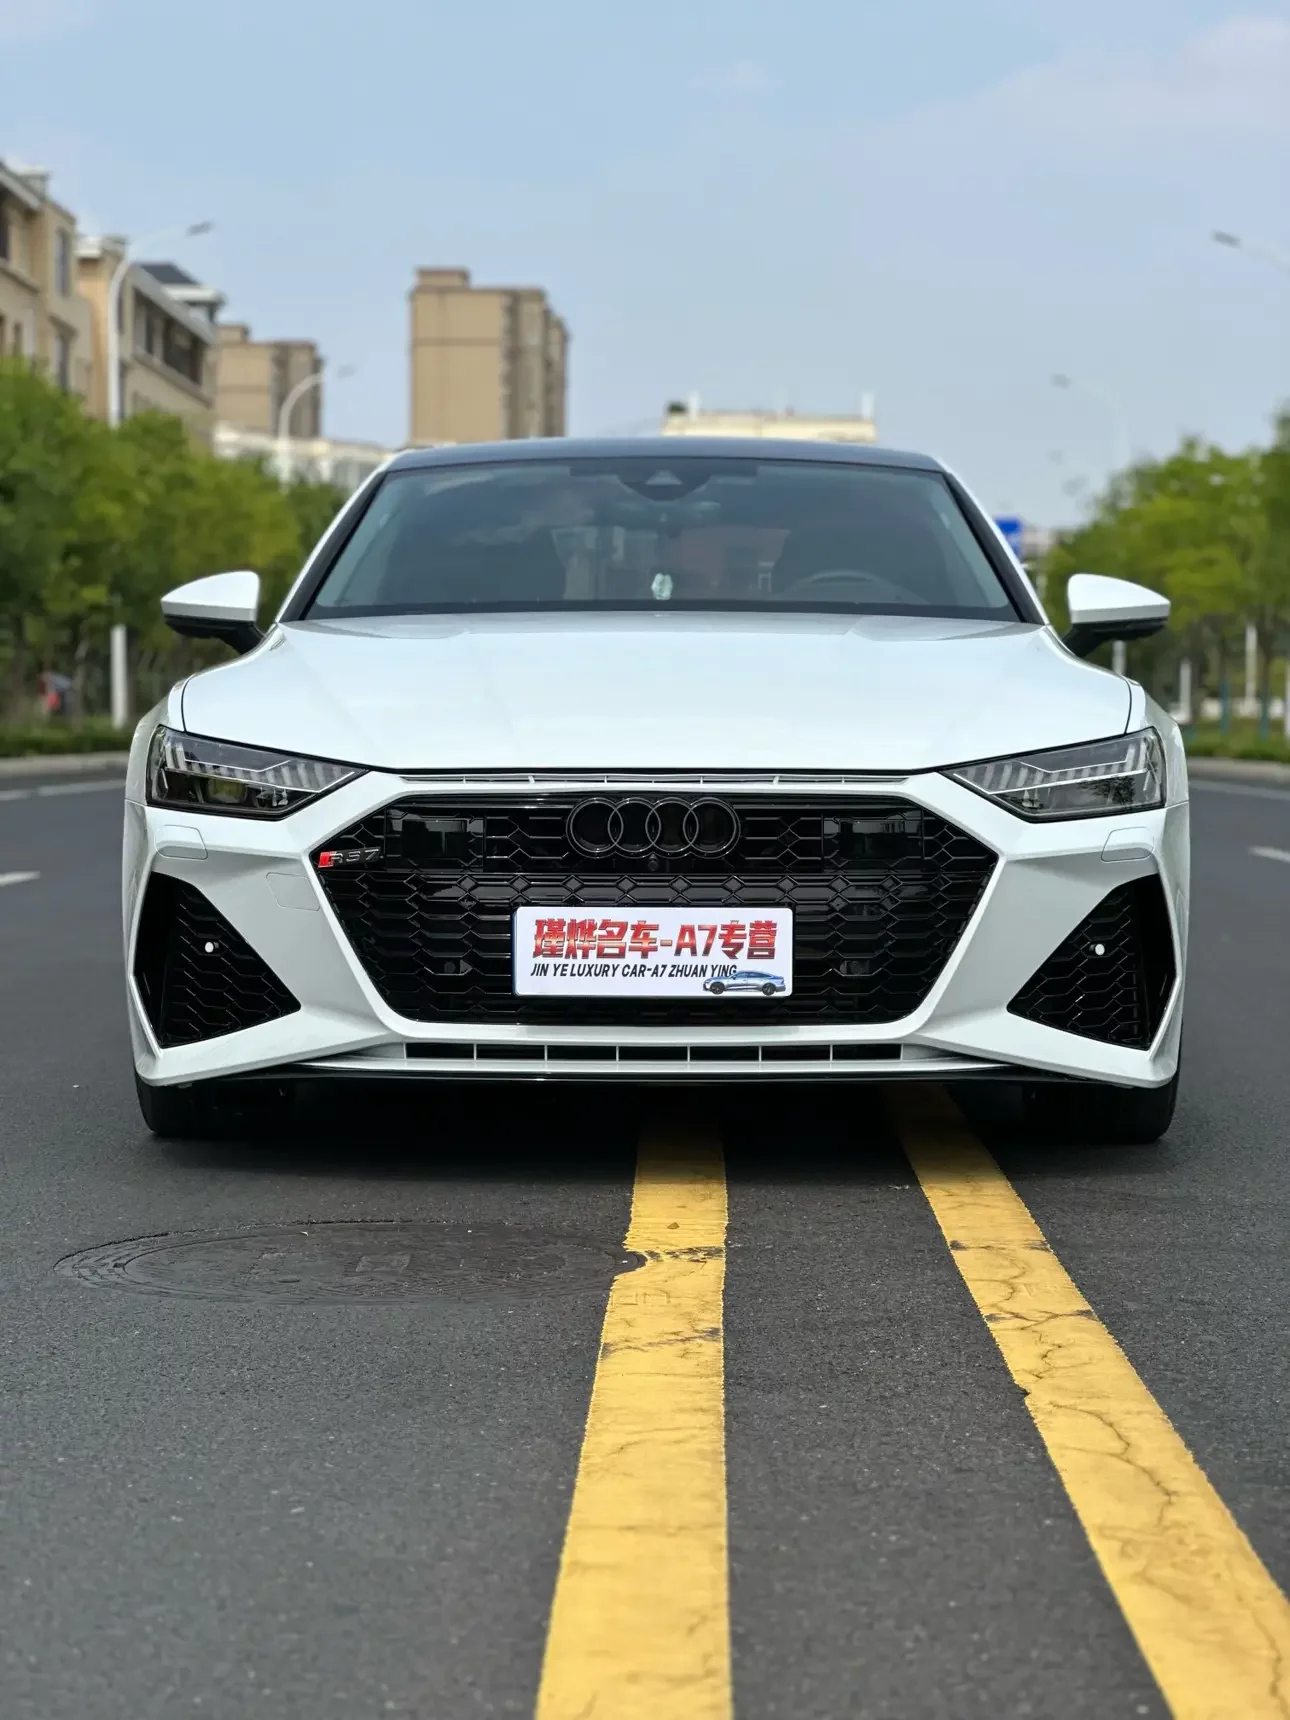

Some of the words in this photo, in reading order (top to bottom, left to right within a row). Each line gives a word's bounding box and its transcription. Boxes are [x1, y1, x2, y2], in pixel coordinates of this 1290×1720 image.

[318, 847, 380, 868] RS7
[532, 918, 778, 961] 瑾烨名车-A7专营
[530, 963, 549, 978] JIN
[552, 963, 569, 978] YE
[569, 963, 621, 978] LUXURY
[621, 963, 668, 978] CAR-A7
[668, 963, 709, 979] ZHUAN
[710, 963, 738, 978] YING
